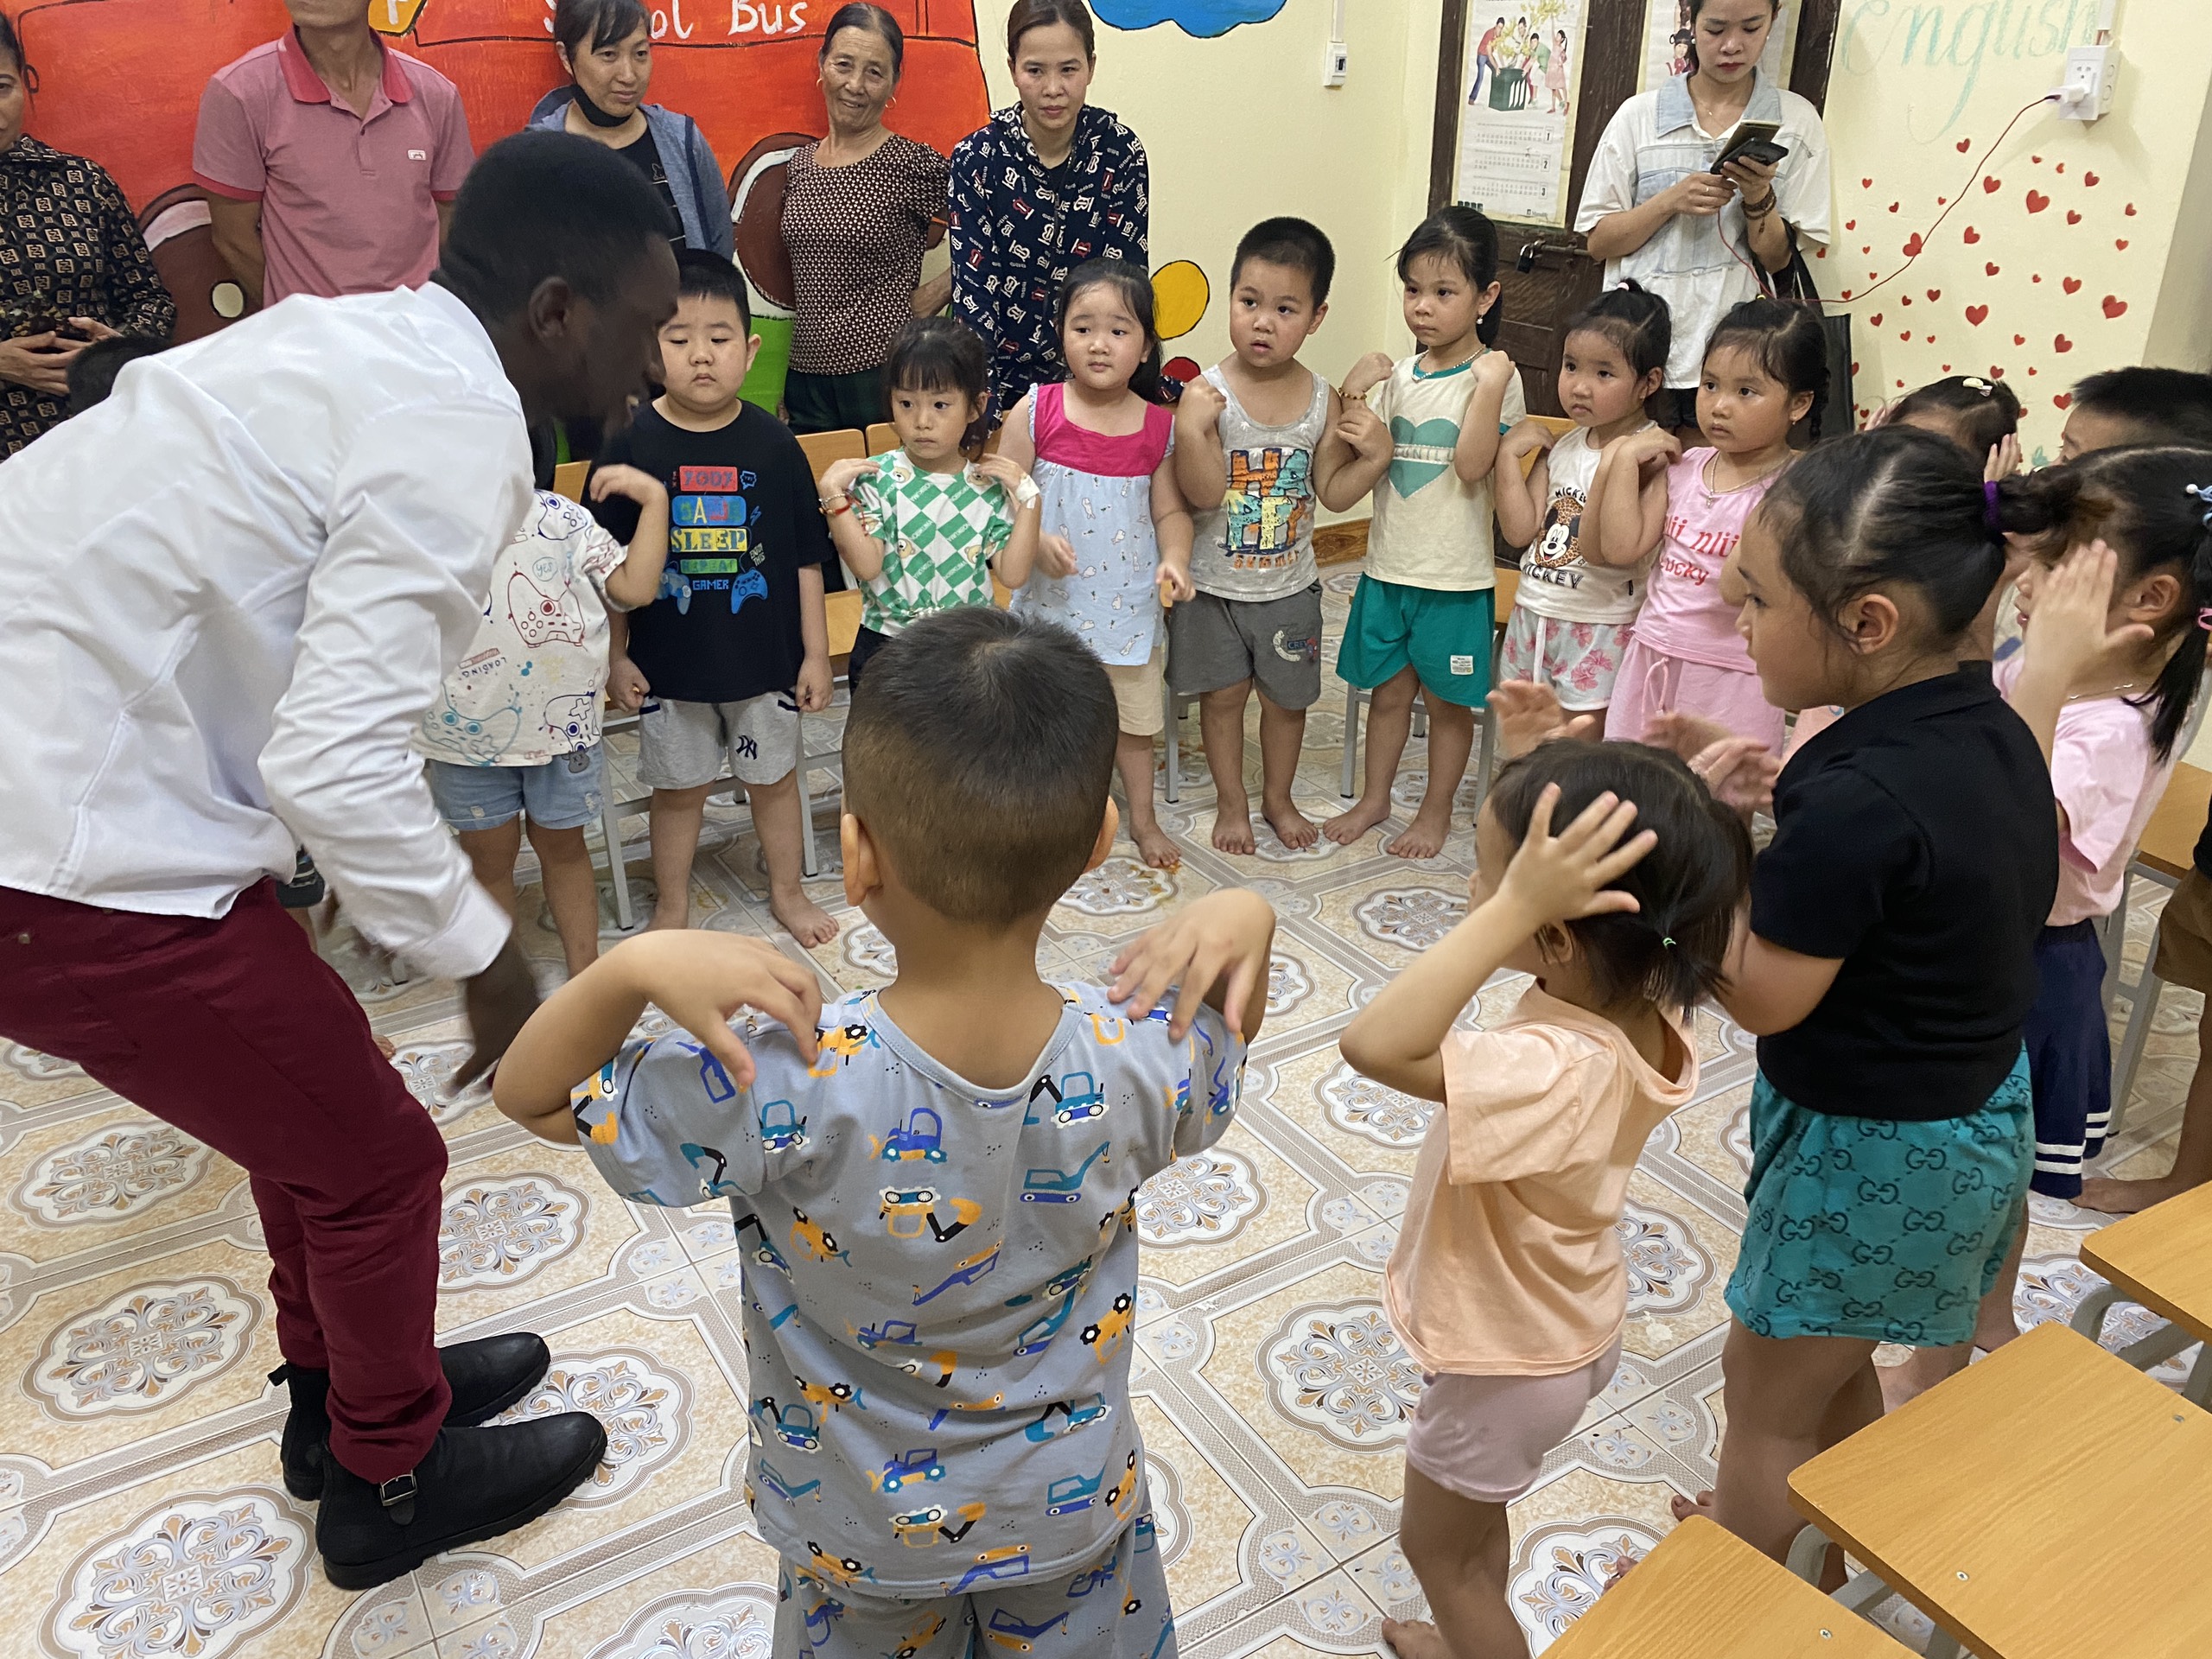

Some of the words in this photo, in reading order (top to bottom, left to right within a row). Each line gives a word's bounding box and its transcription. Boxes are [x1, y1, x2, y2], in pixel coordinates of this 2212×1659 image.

[728, 0, 808, 36] Bus
[671, 526, 746, 553] SLEEP
[692, 579, 729, 591] GAMER
[1660, 557, 1709, 586] ucky
[461, 657, 507, 678] LOADING
